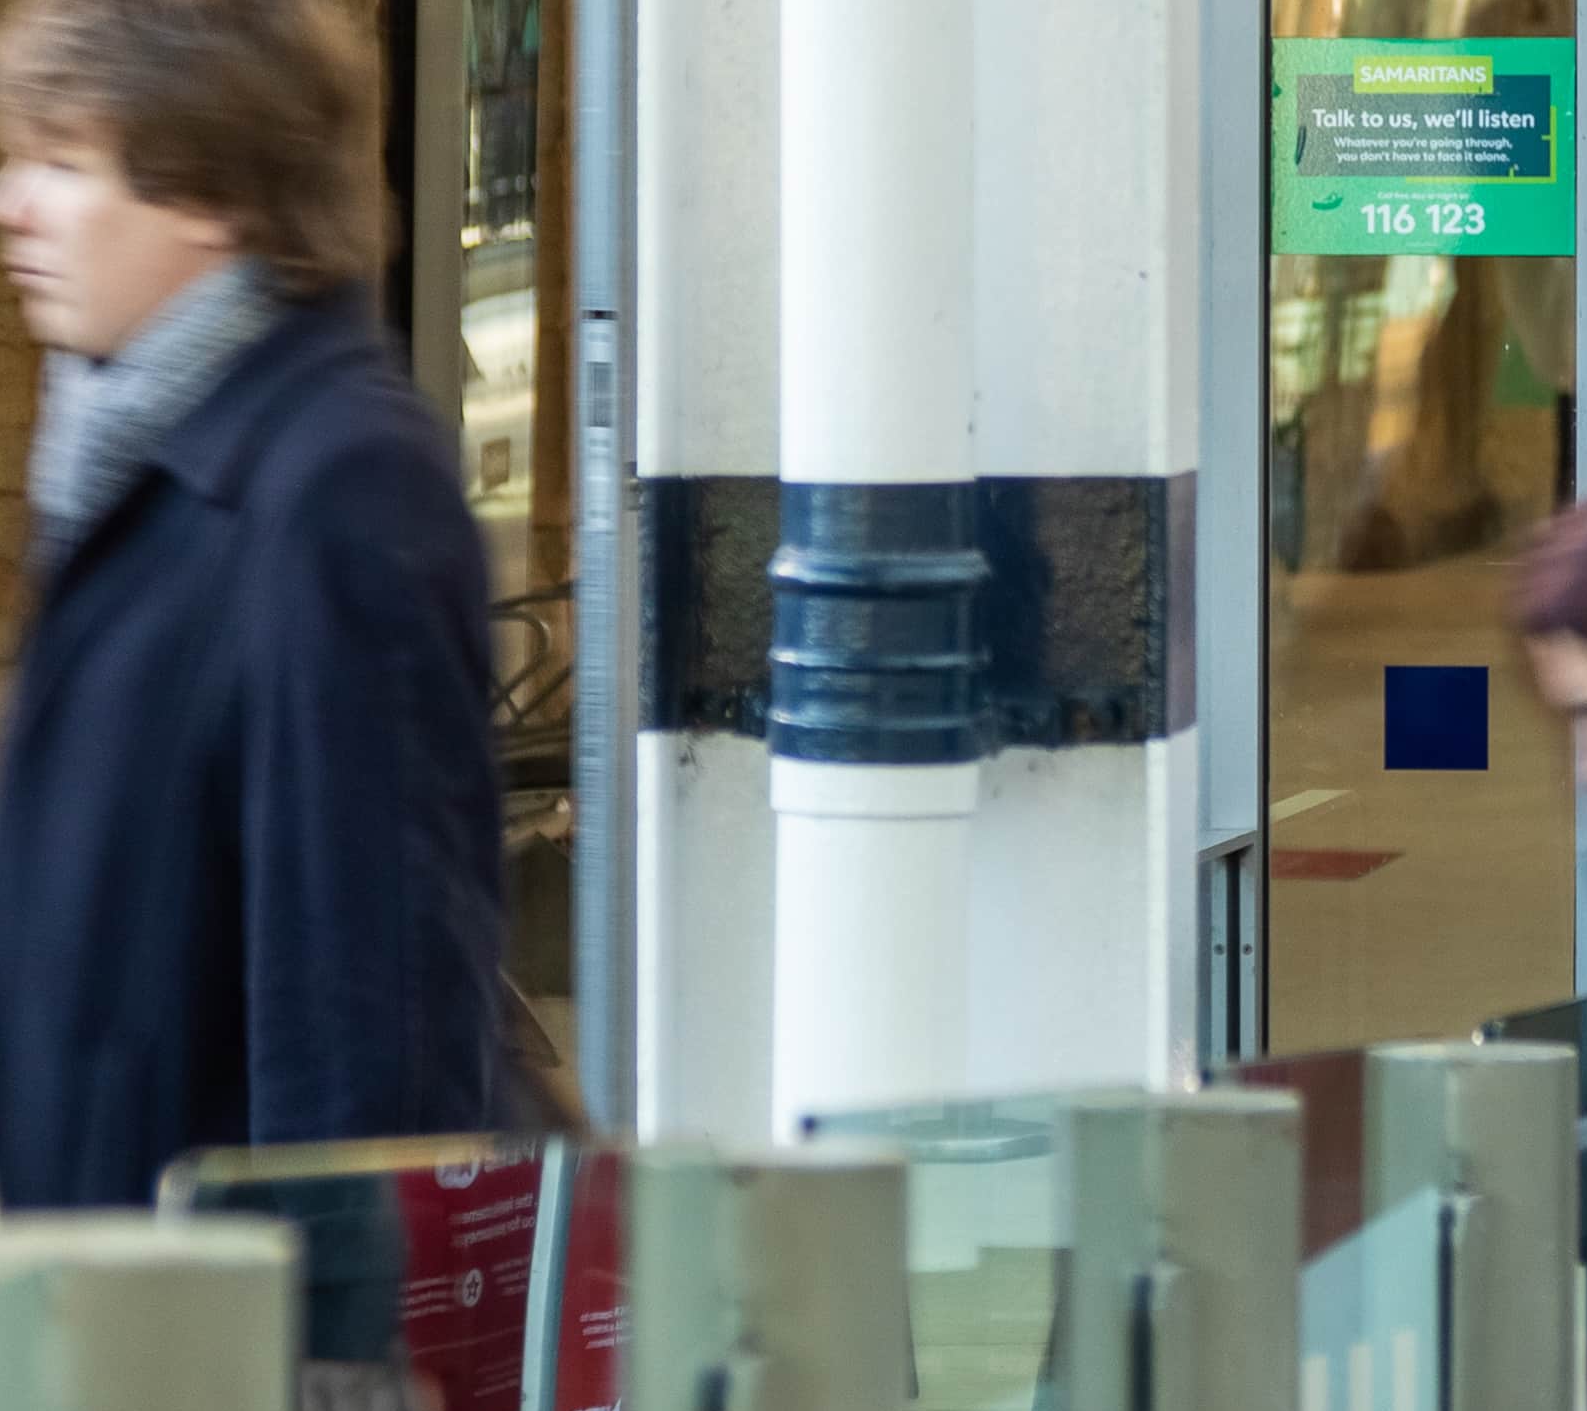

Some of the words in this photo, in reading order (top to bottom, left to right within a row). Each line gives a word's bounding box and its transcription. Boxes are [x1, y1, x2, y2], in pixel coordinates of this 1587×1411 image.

[1359, 65, 1487, 84] SAMARITANS
[1312, 108, 1355, 129] Talk
[1361, 111, 1384, 129] to
[1389, 112, 1417, 131] us,
[1423, 108, 1473, 129] we'll
[1478, 107, 1536, 129] listen
[1333, 136, 1389, 148] Whatever
[1429, 137, 1463, 150] going
[1465, 136, 1513, 151] through,
[1336, 152, 1358, 164] you
[1392, 150, 1421, 162] have
[1423, 151, 1436, 162] to
[1437, 150, 1463, 163] face
[1464, 150, 1473, 163] it
[1474, 151, 1511, 163] alone.
[1361, 203, 1417, 235] 116
[1424, 203, 1487, 235] 123
